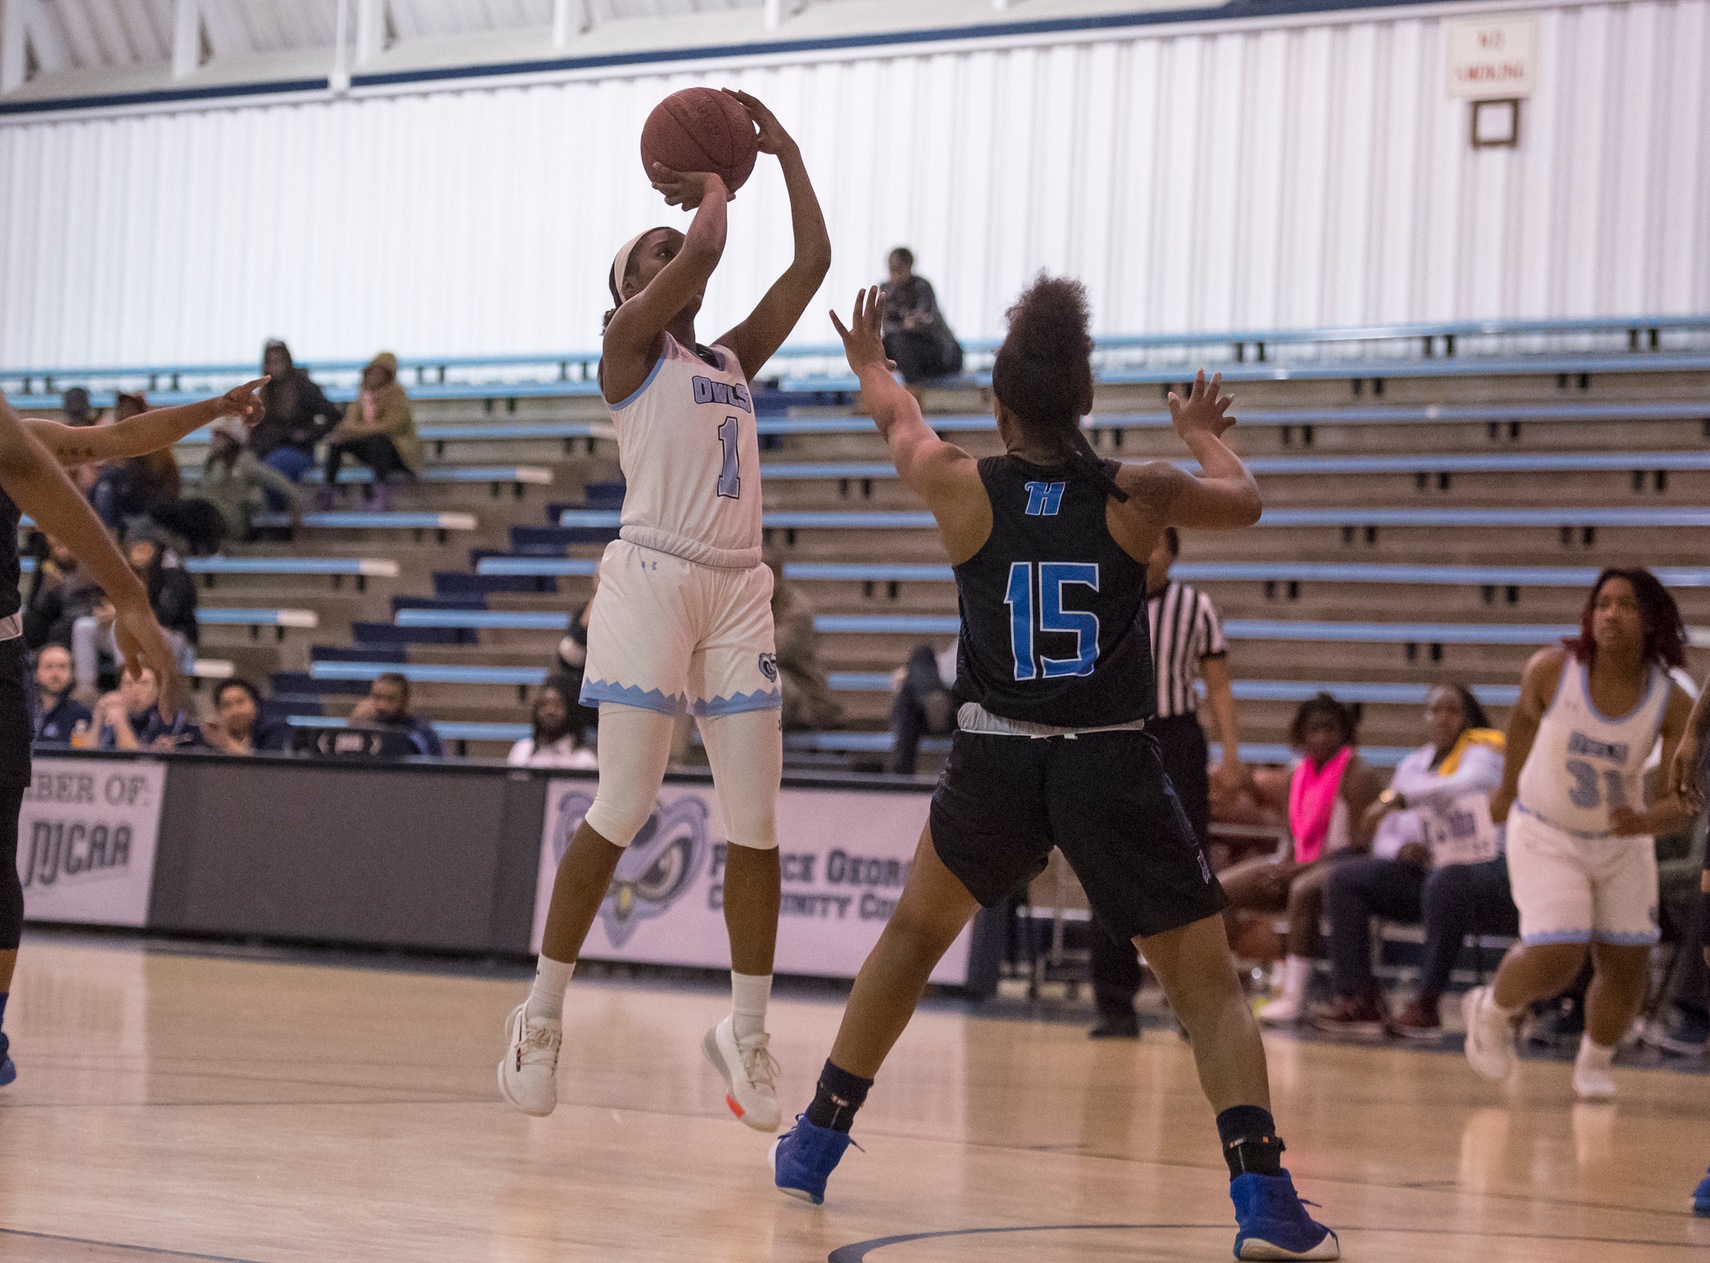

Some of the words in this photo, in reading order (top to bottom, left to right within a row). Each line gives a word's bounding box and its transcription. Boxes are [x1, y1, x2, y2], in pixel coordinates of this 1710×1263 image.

[692, 375, 752, 413] OWLS
[717, 415, 741, 500] 1
[1024, 477, 1066, 516] H
[1003, 561, 1100, 681] 15
[25, 772, 95, 803] BER
[1565, 757, 1625, 811] 31
[23, 820, 132, 889] NJCAA
[709, 842, 816, 883] PCE
